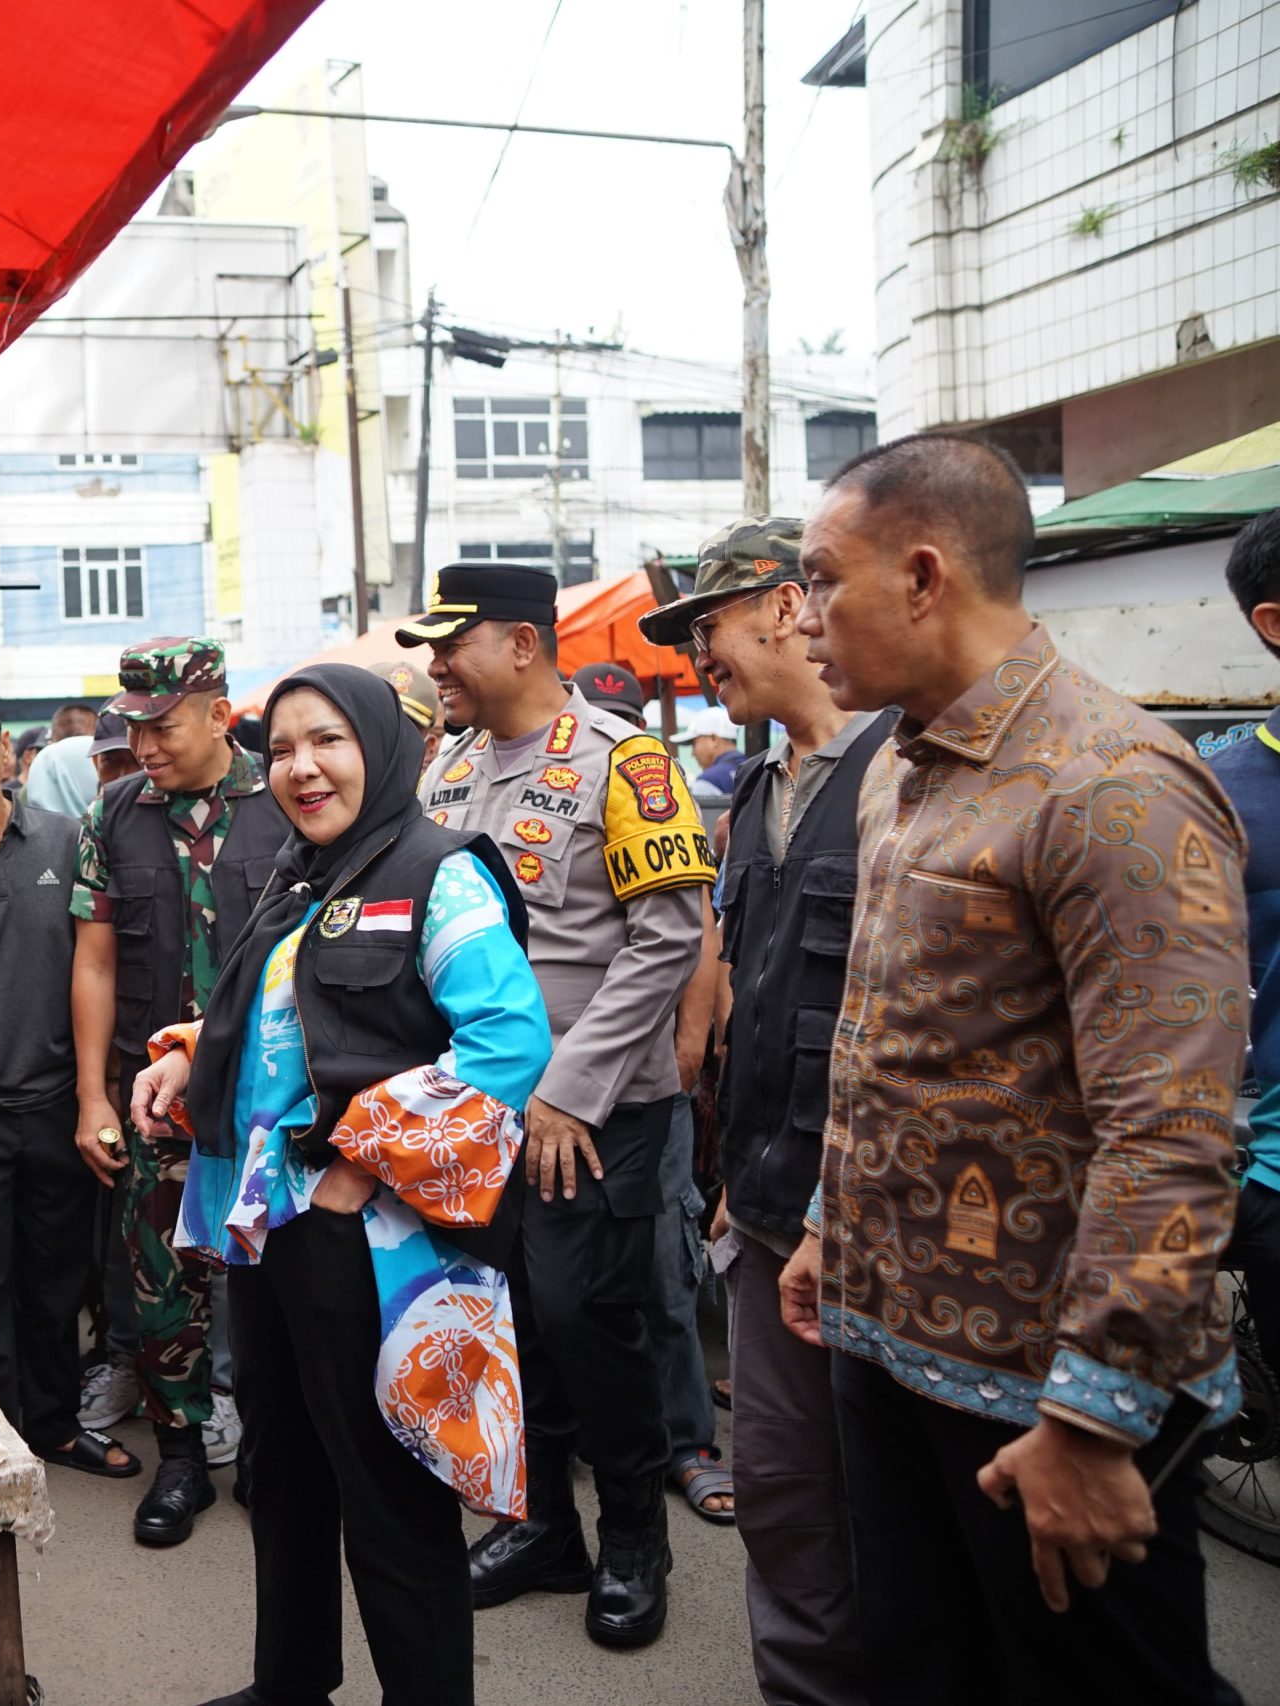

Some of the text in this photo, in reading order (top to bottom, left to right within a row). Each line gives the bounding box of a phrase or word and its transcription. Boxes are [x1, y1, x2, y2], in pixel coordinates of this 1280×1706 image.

[520, 789, 579, 816] POLRI
[609, 846, 640, 887] KA
[644, 833, 691, 873] OPS
